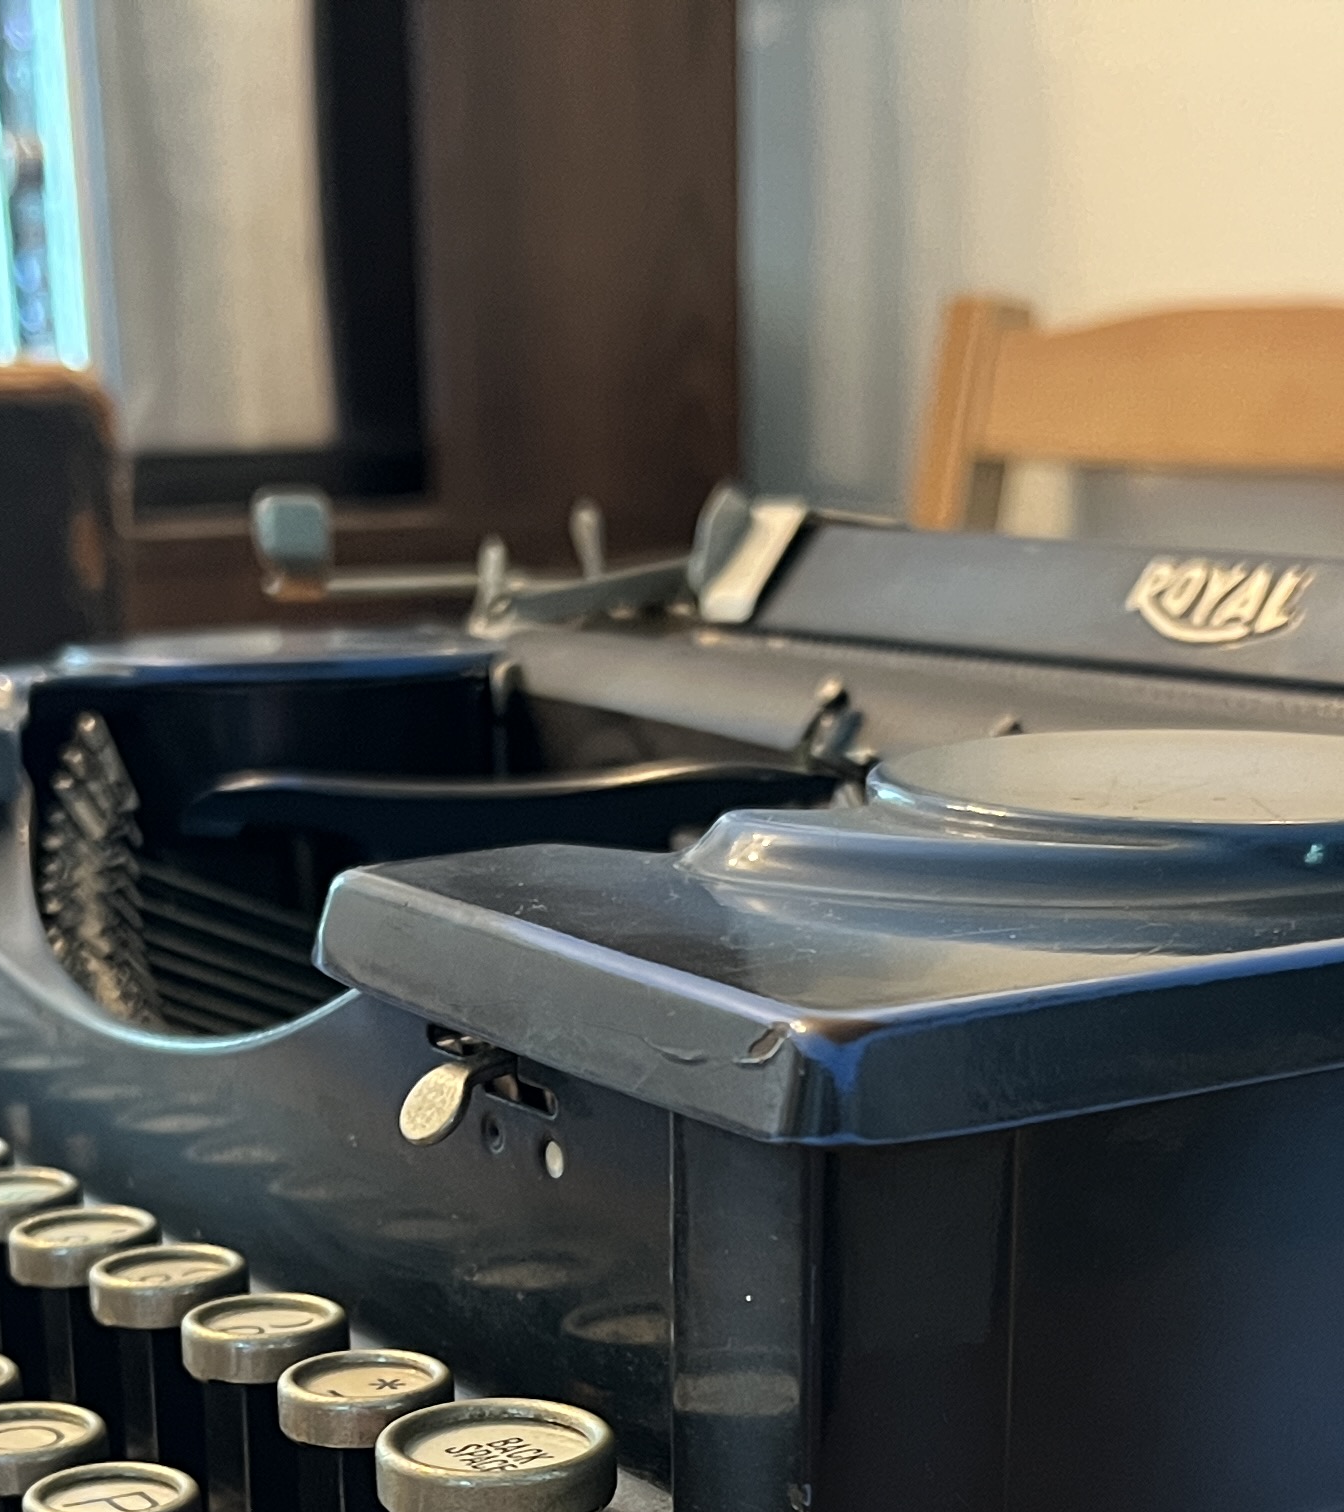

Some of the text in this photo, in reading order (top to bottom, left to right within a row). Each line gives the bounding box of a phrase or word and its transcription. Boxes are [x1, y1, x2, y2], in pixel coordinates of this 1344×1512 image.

[1125, 557, 1313, 643] ROYAL
[443, 1442, 518, 1473] SPACE
[484, 1436, 556, 1465] BACK
[62, 1490, 160, 1512] P
